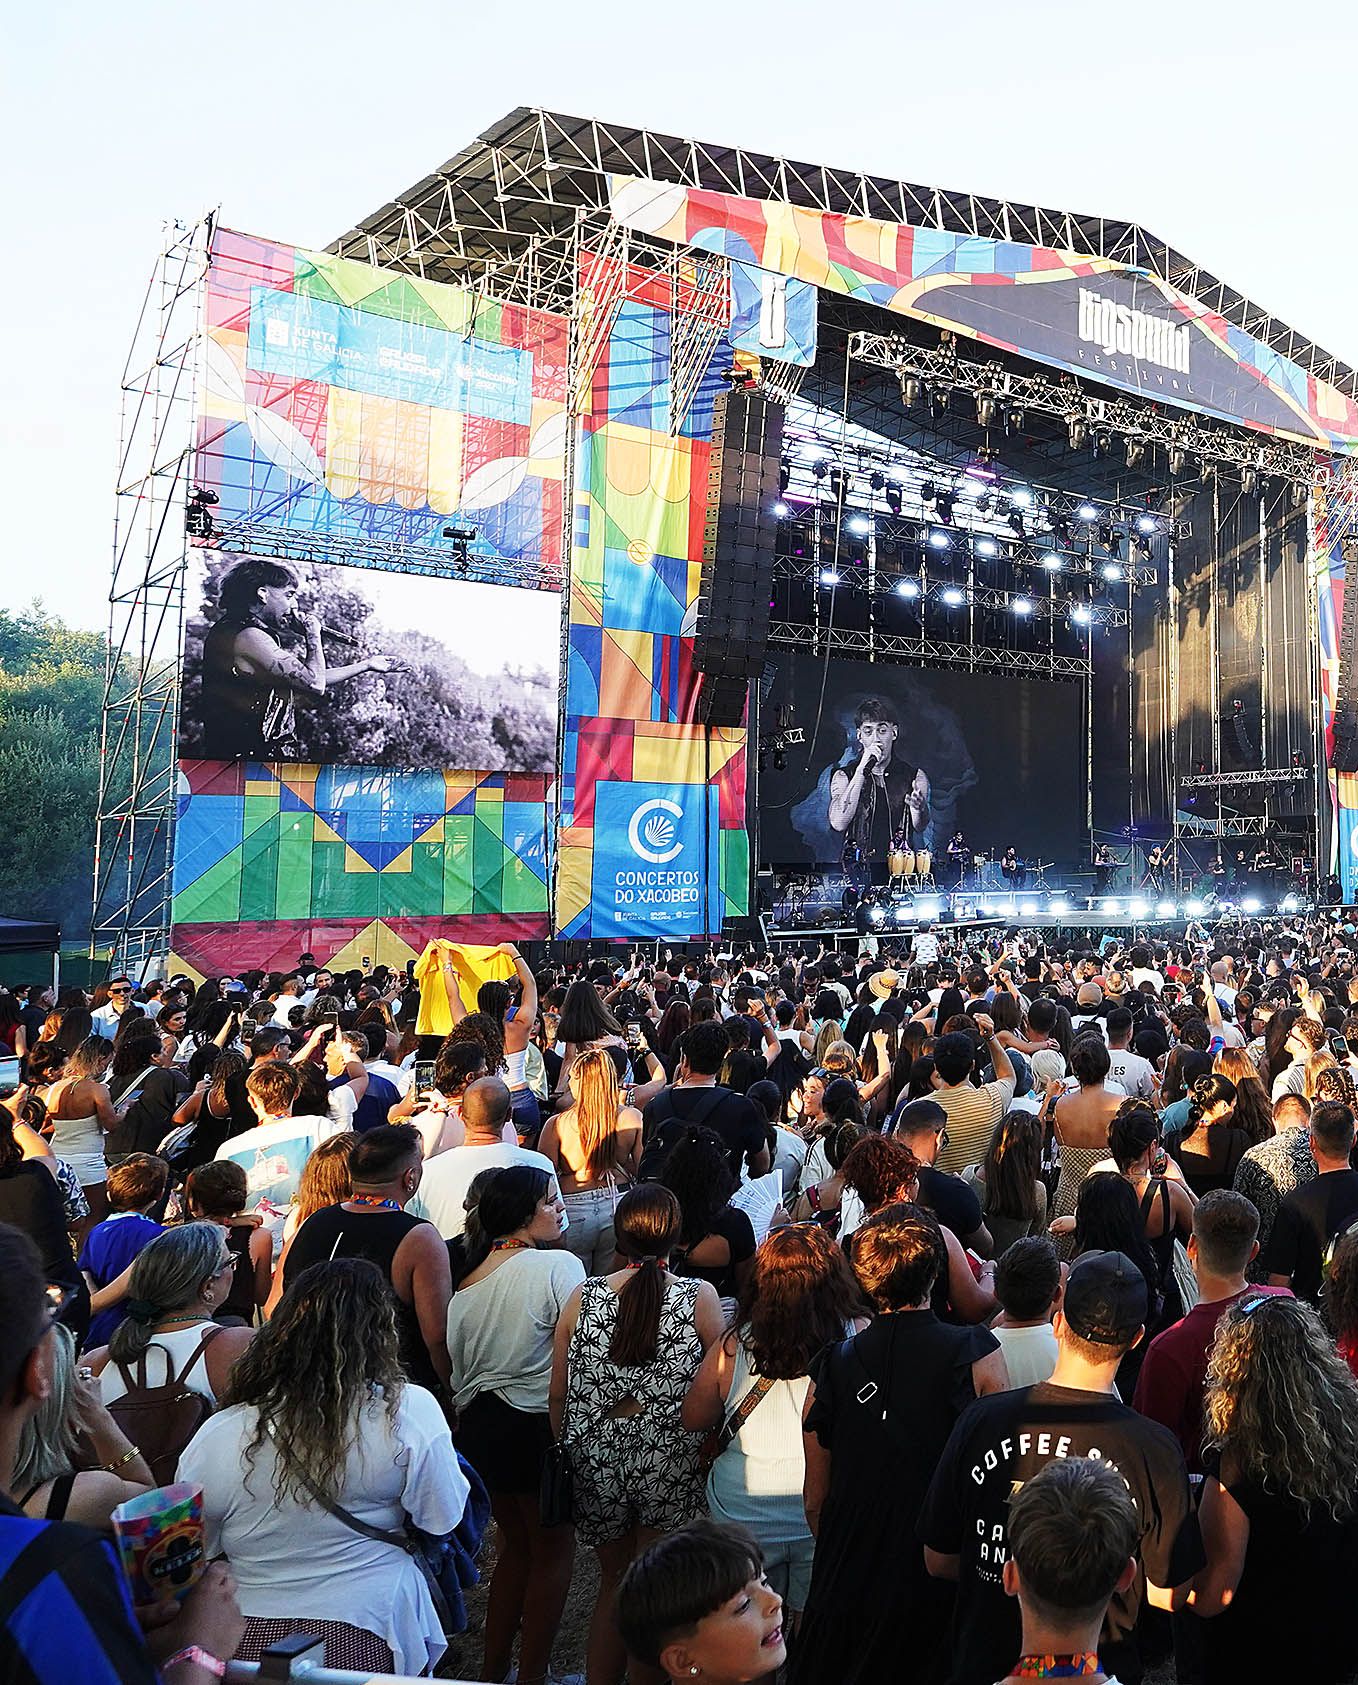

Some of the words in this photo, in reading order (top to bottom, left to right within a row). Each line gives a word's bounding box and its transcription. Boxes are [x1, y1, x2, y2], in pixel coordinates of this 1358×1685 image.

[615, 871, 699, 886] CONCERTOS
[615, 889, 634, 904] DO
[637, 888, 699, 903] XACOBEO
[971, 1433, 1072, 1485] COFFEE
